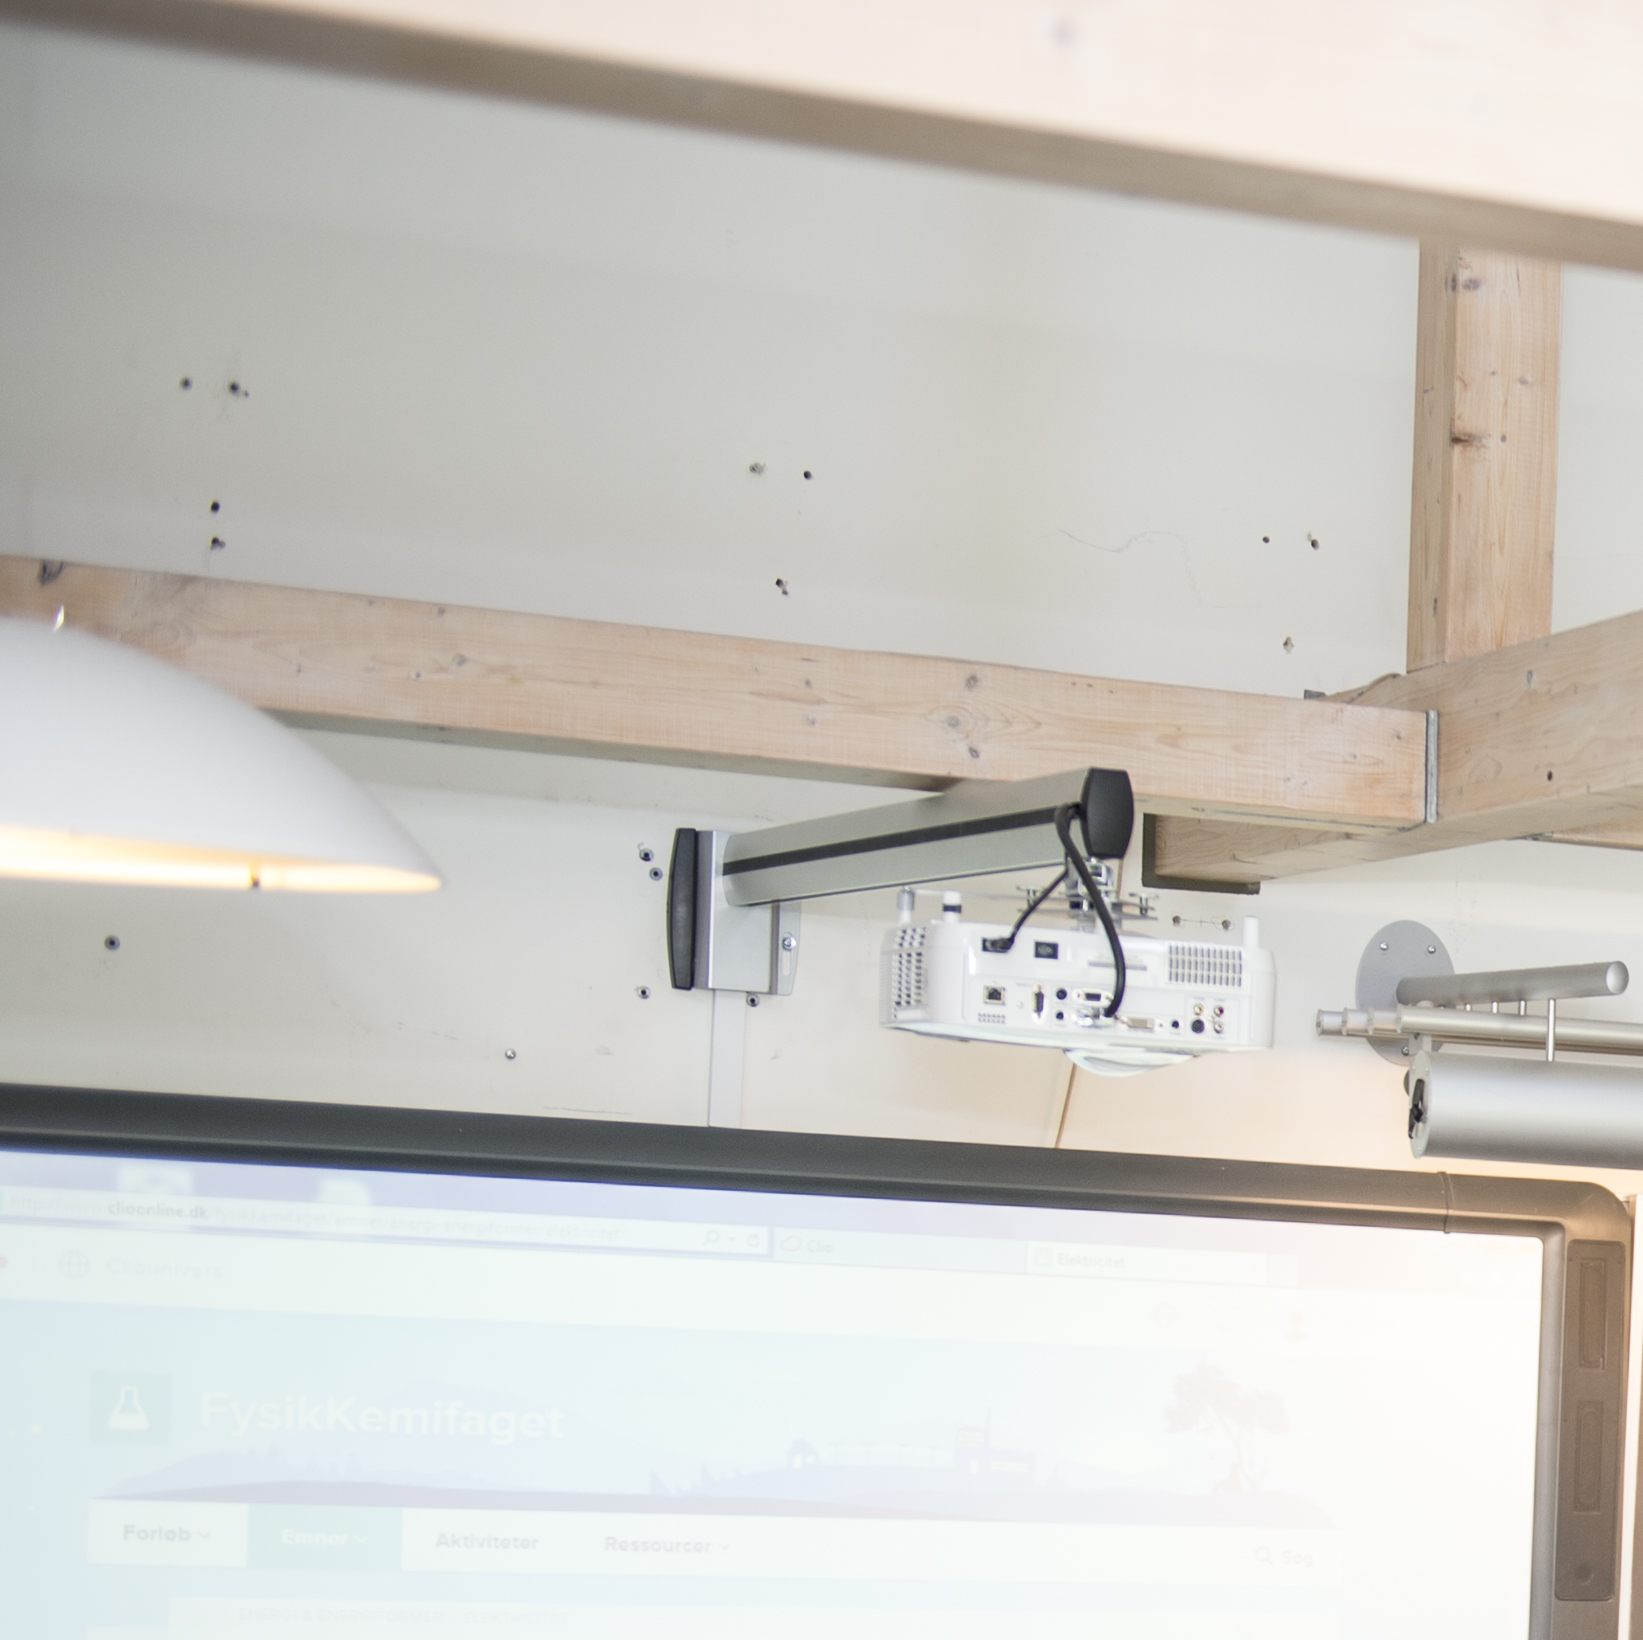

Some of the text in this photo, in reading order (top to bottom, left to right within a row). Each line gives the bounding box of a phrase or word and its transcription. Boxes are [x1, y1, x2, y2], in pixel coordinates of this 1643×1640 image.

[199, 1390, 566, 1447] FysikKemifaget
[122, 1522, 192, 1543] Forløb
[280, 1528, 349, 1548] Emner
[434, 1531, 539, 1552] Aktiviteter
[603, 1536, 713, 1555] Ressourcer
